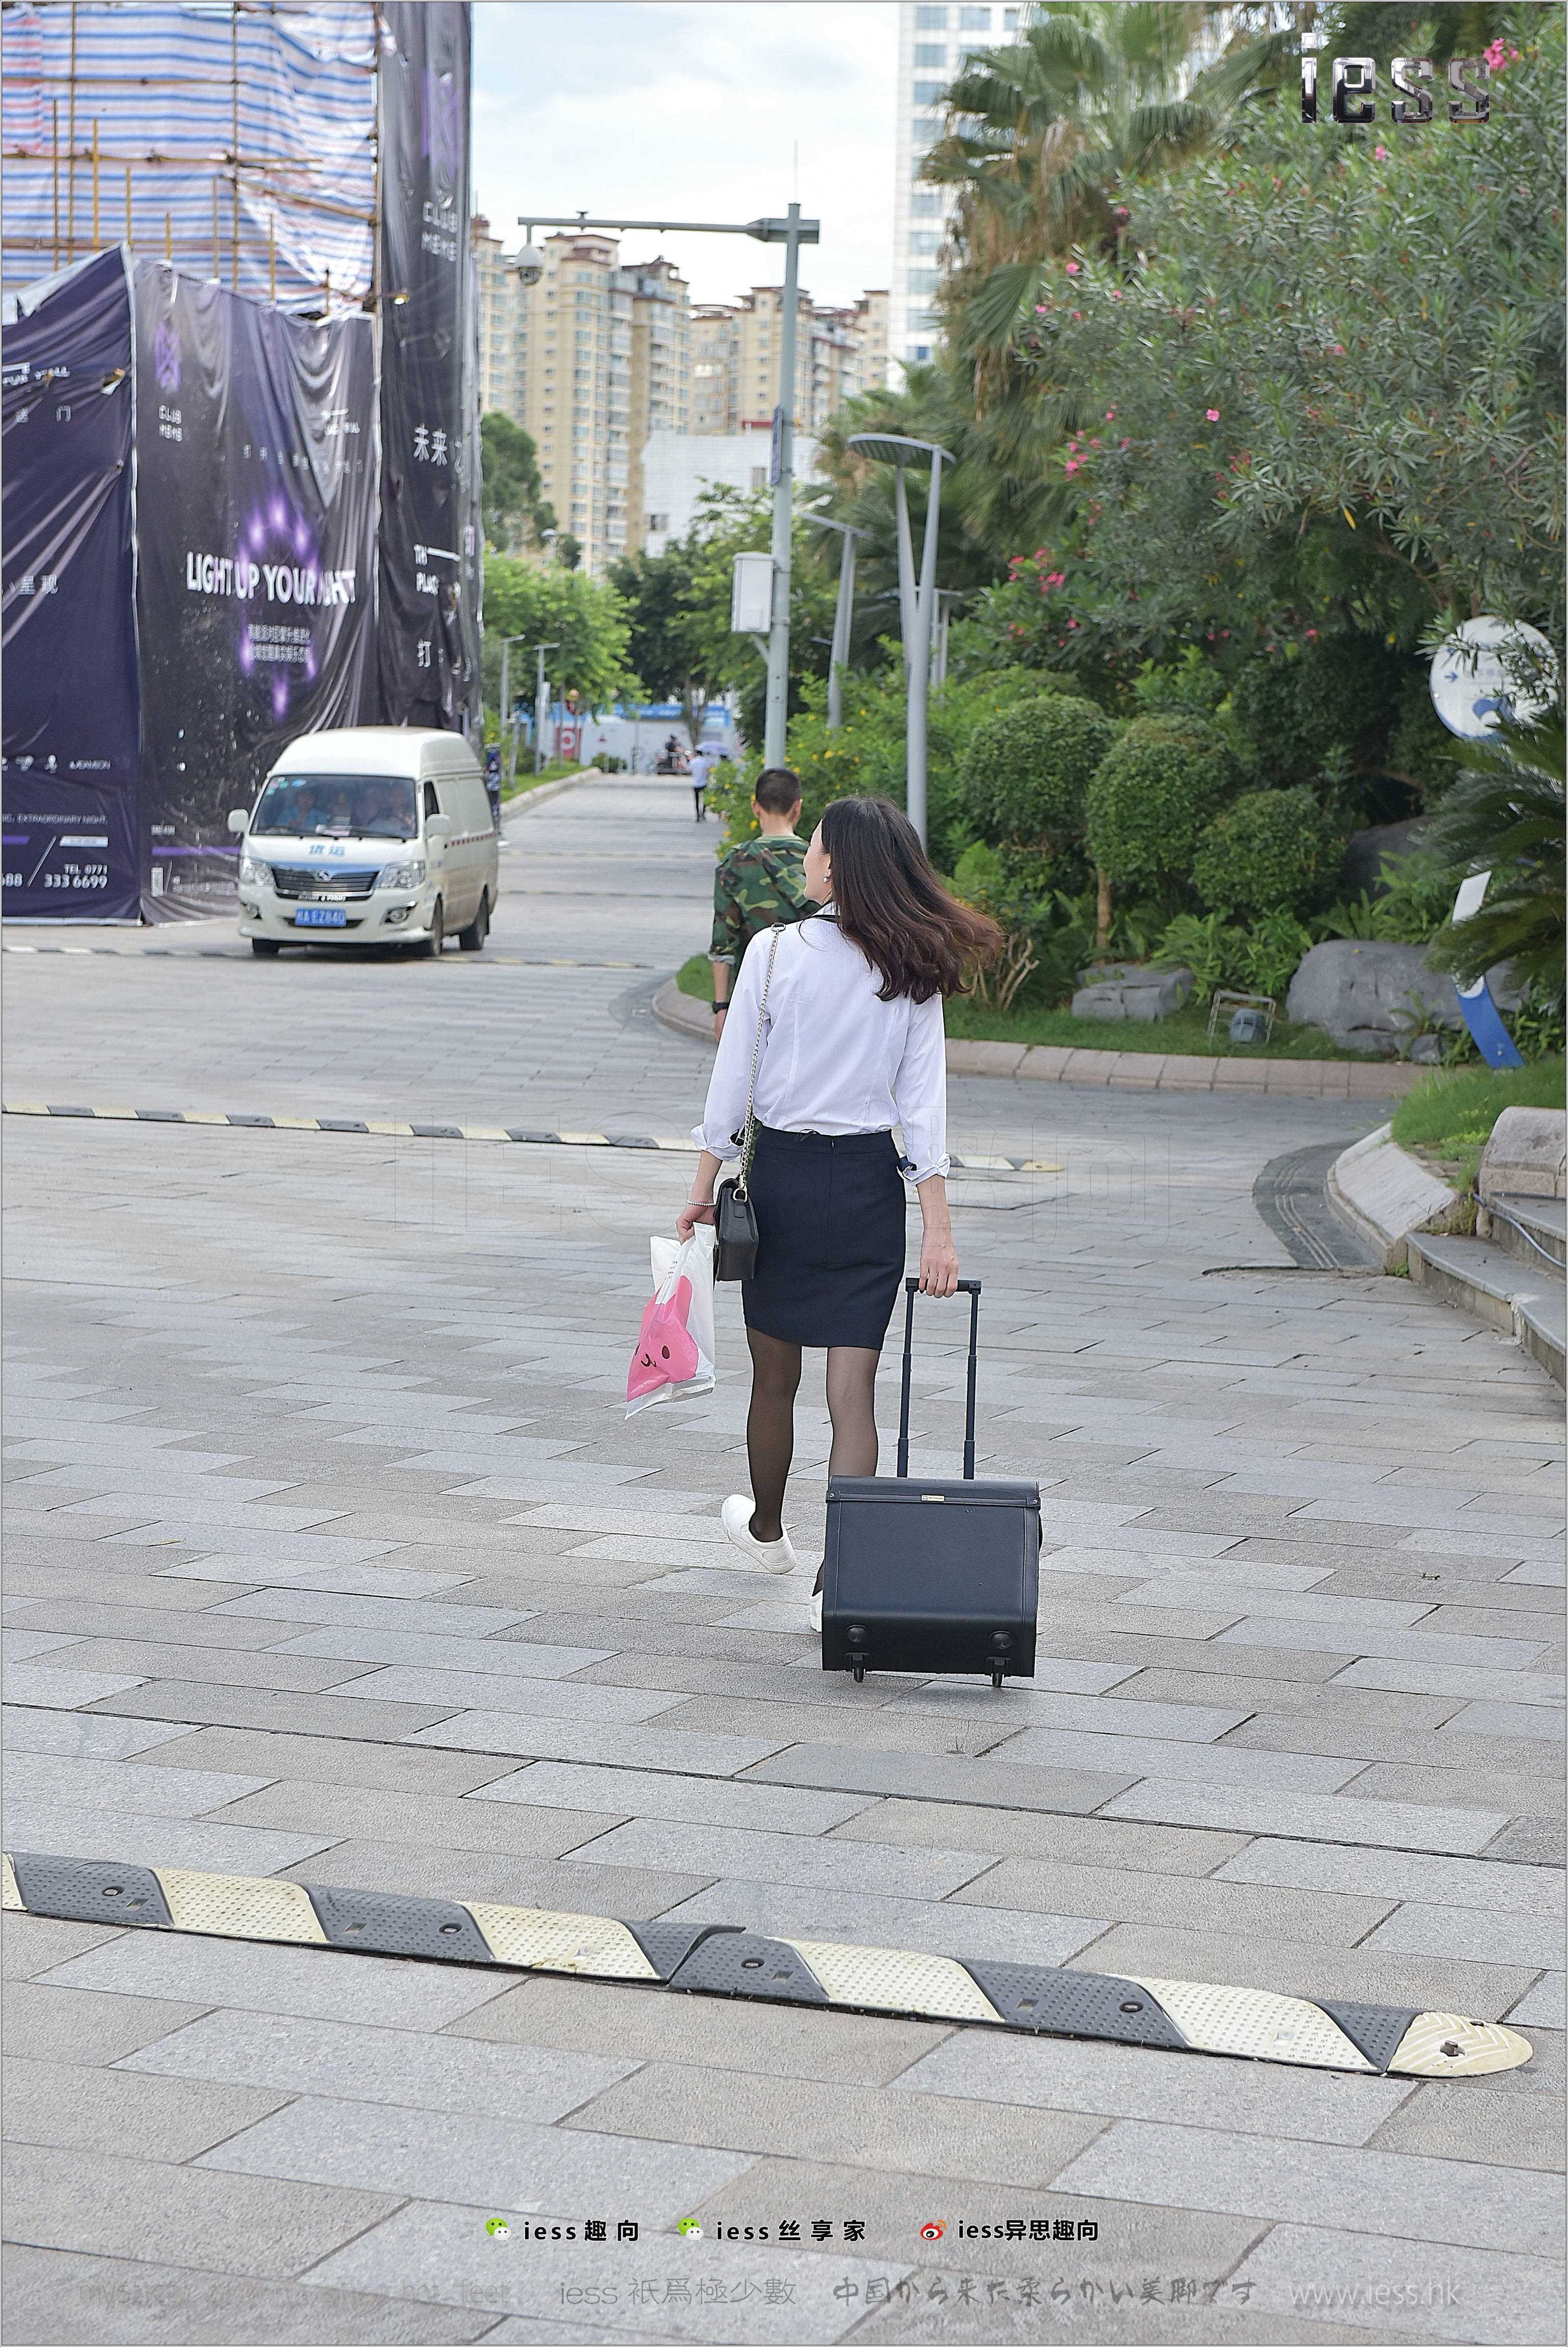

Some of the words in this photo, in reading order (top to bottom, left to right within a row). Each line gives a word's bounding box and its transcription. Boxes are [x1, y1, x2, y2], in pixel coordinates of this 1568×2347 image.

[414, 423, 447, 467] 未来
[186, 552, 233, 596] LIGHT
[234, 559, 260, 599] UP
[262, 563, 316, 605] YOUR
[43, 873, 70, 888] 333
[72, 874, 108, 889] 6699
[63, 863, 81, 875] TEL
[84, 864, 107, 875] 0771
